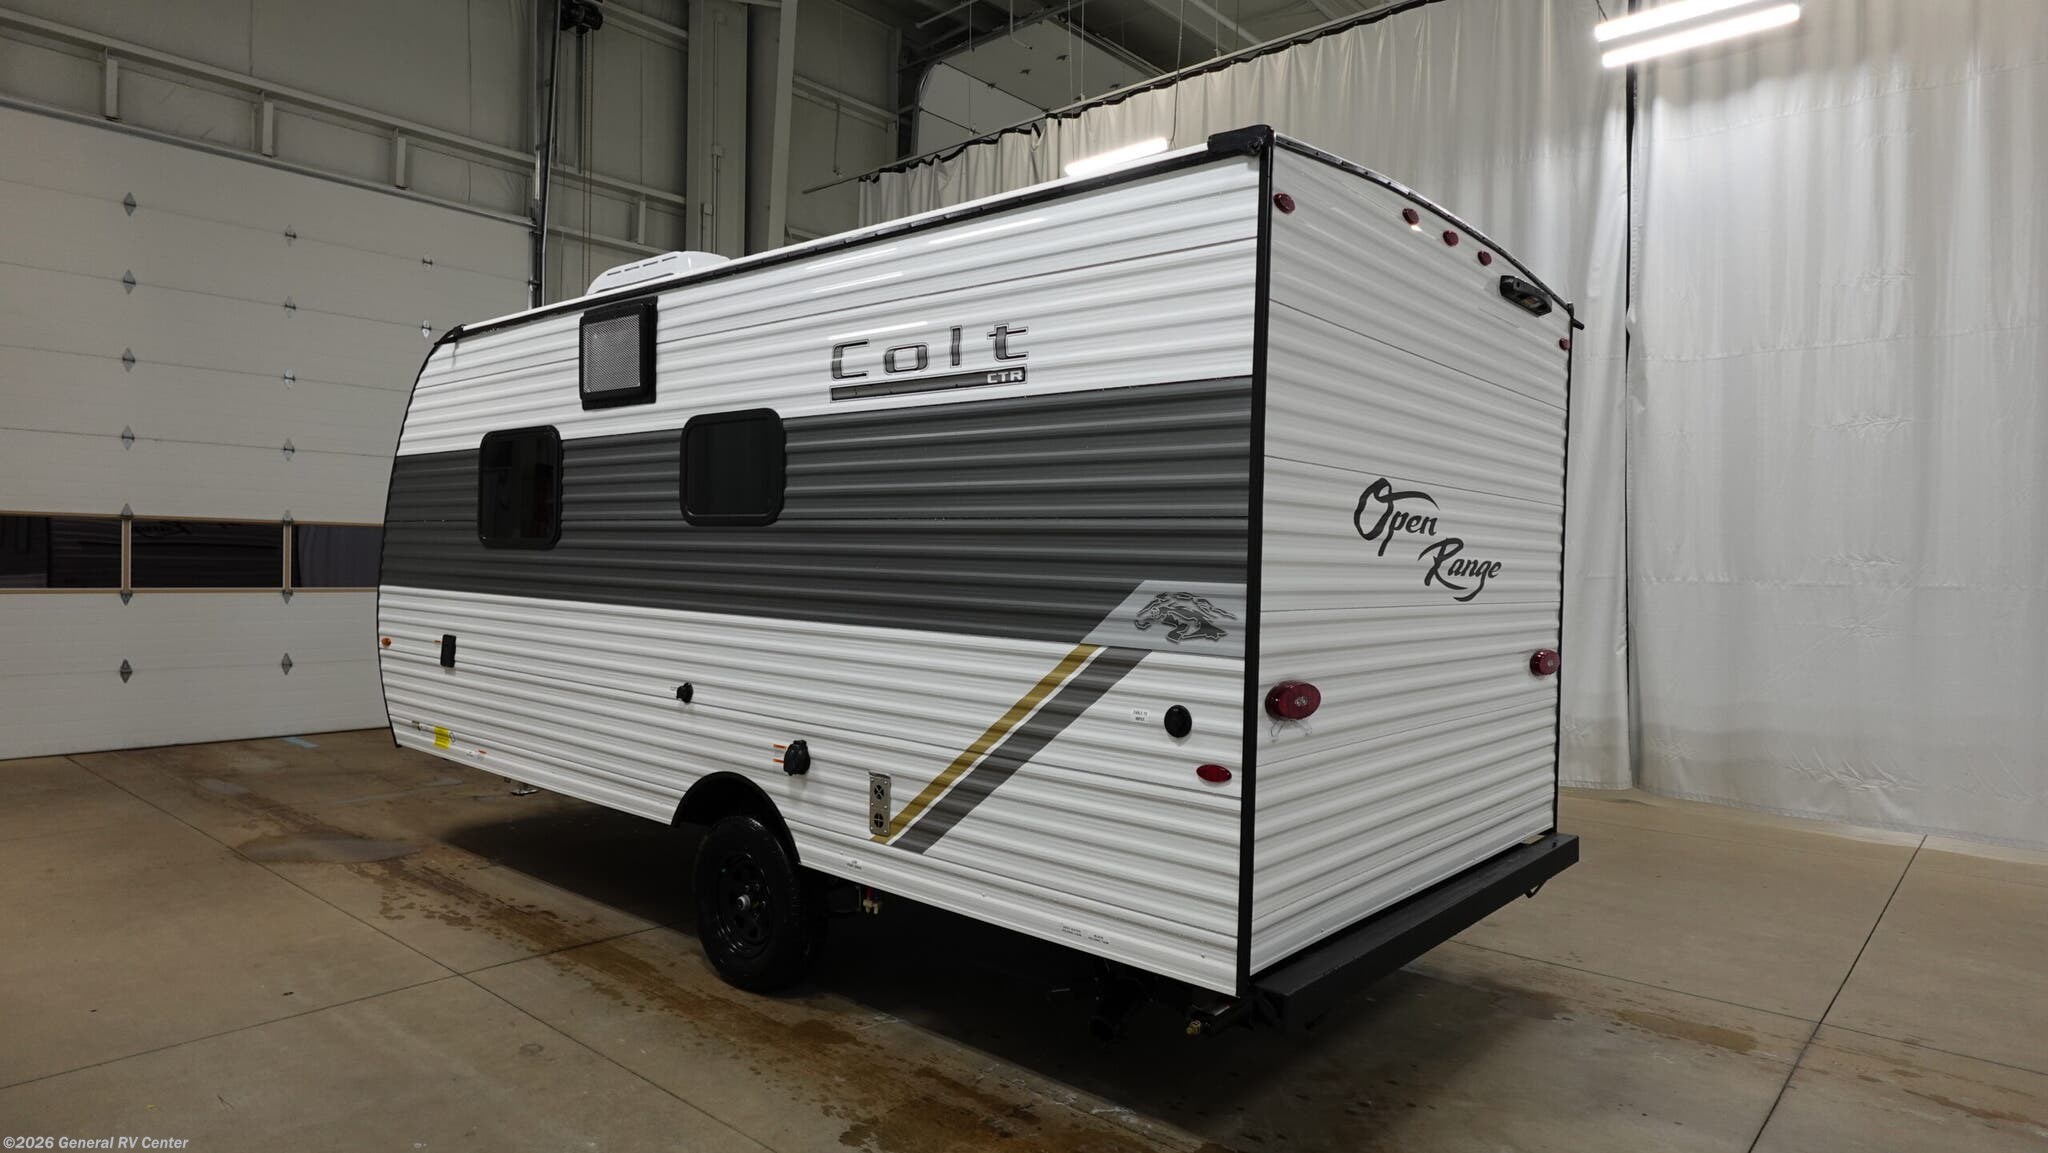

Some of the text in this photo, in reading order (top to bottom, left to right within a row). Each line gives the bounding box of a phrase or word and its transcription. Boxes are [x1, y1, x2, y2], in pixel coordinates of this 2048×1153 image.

[832, 323, 1028, 381] Colt
[986, 370, 1024, 385] CTR
[1353, 477, 1440, 557] Open
[1417, 537, 1502, 602] Range
